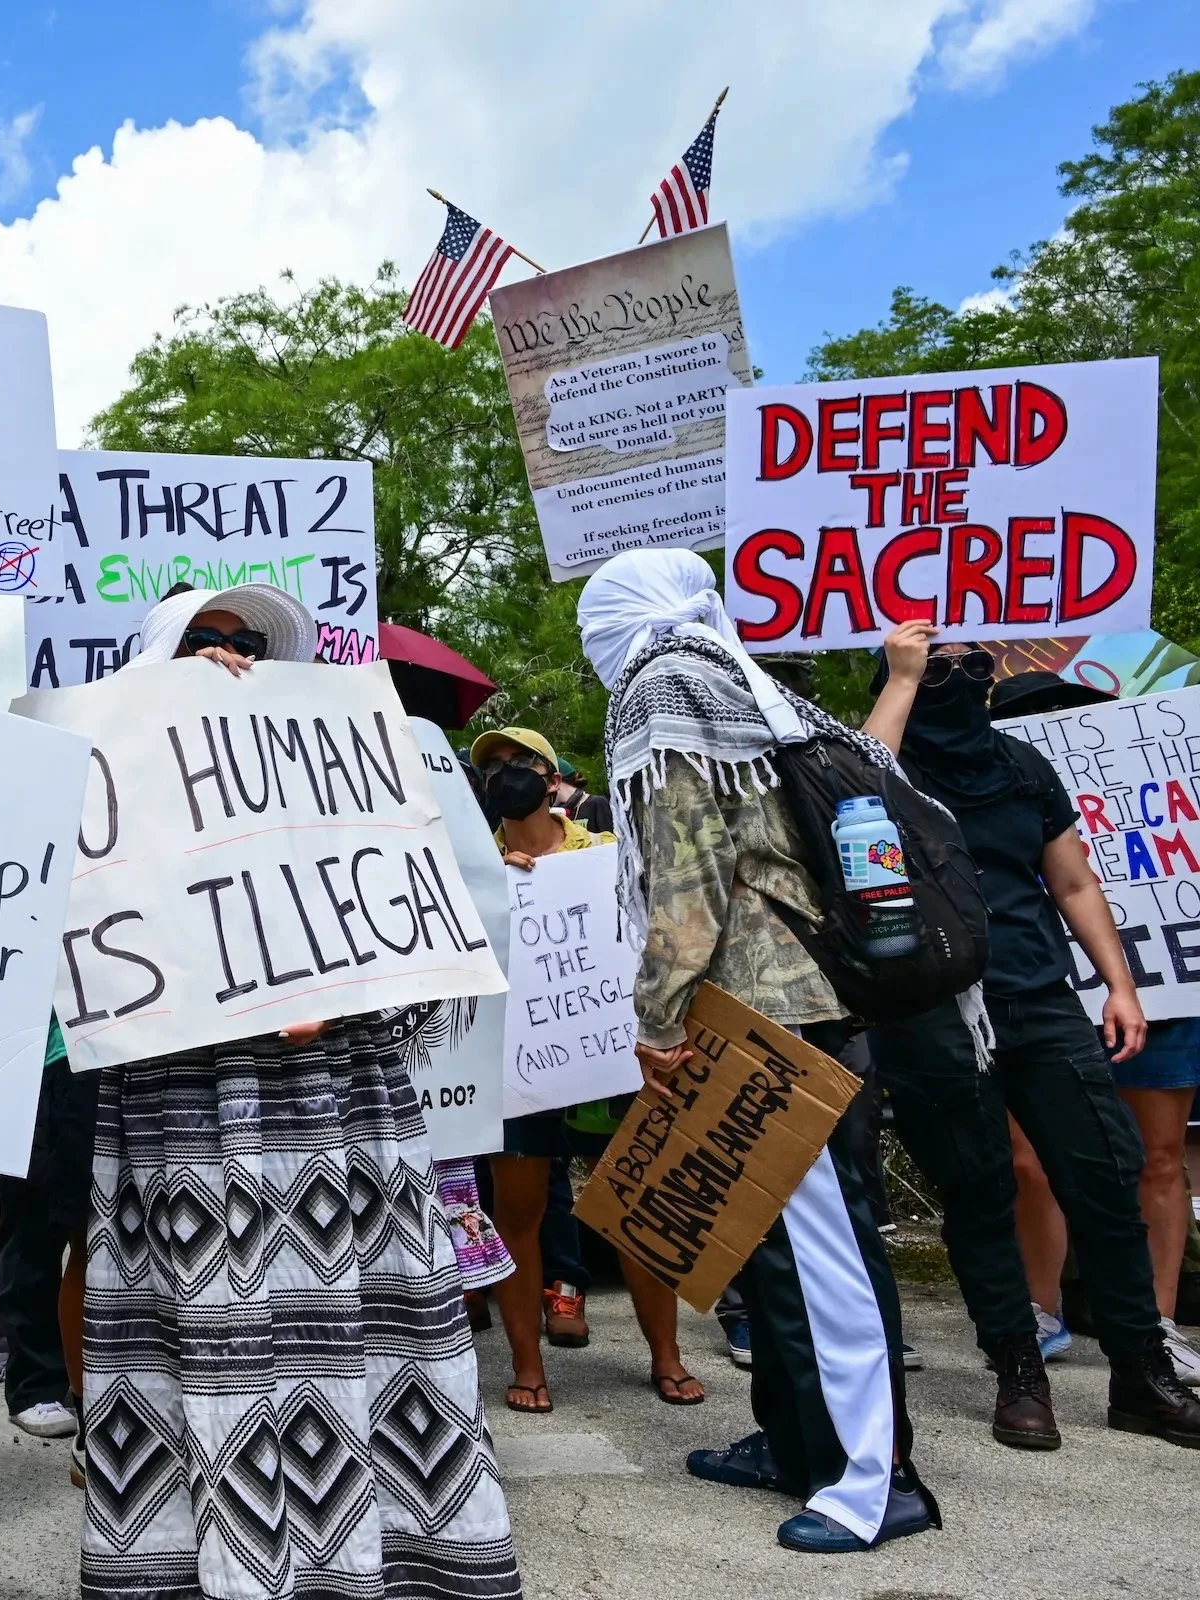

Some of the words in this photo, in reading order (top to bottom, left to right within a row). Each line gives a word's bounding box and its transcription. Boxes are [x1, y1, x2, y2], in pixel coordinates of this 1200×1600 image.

[502, 311, 557, 353] We
[560, 303, 602, 346] the
[603, 274, 711, 332] People
[550, 377, 567, 389] As
[570, 374, 578, 383] a
[580, 362, 641, 380] Veteran,
[644, 355, 651, 366] I
[654, 346, 698, 364] swore
[701, 341, 716, 352] to
[550, 384, 597, 403] defend
[600, 378, 624, 392] the
[626, 357, 721, 385] Constitution.
[550, 421, 574, 435] Not
[578, 420, 585, 428] a
[588, 409, 632, 427] KING.
[635, 403, 661, 416] Not
[665, 401, 673, 409] a
[676, 384, 728, 406] PARTY
[558, 431, 585, 447] And
[589, 428, 619, 442] sure
[622, 423, 638, 433] as
[641, 415, 668, 430] hell
[671, 410, 695, 423] not
[698, 404, 725, 419] you
[756, 379, 1068, 481] DEFEND
[616, 429, 672, 450] Donald.
[557, 467, 661, 500] Undocumented
[665, 456, 723, 476] humans
[571, 500, 594, 513] not
[597, 488, 655, 507] enemies
[658, 484, 672, 495] of
[675, 477, 698, 491] the
[850, 468, 970, 528] THE
[97, 469, 299, 542] THREAT
[308, 475, 366, 534] 2
[583, 531, 595, 543] If
[597, 521, 650, 542] seeking
[652, 509, 713, 529] freedom
[566, 545, 609, 562] crime,
[612, 538, 643, 552] then
[646, 525, 704, 546] America
[708, 520, 720, 531] is
[318, 556, 368, 616] IS
[732, 506, 1137, 642] SACRED
[30, 637, 60, 688] A
[1118, 700, 1186, 742] IS
[167, 711, 406, 832] HUMAN
[860, 890, 883, 900] FREE
[1130, 880, 1200, 920] TO
[62, 910, 165, 1029] IS
[187, 846, 487, 1004] ILLEGAL
[519, 903, 591, 947] OUT
[535, 946, 596, 983] THE
[516, 1043, 570, 1084] (AND
[440, 1084, 476, 1109] DO?
[605, 1095, 680, 1210] ABOLISH
